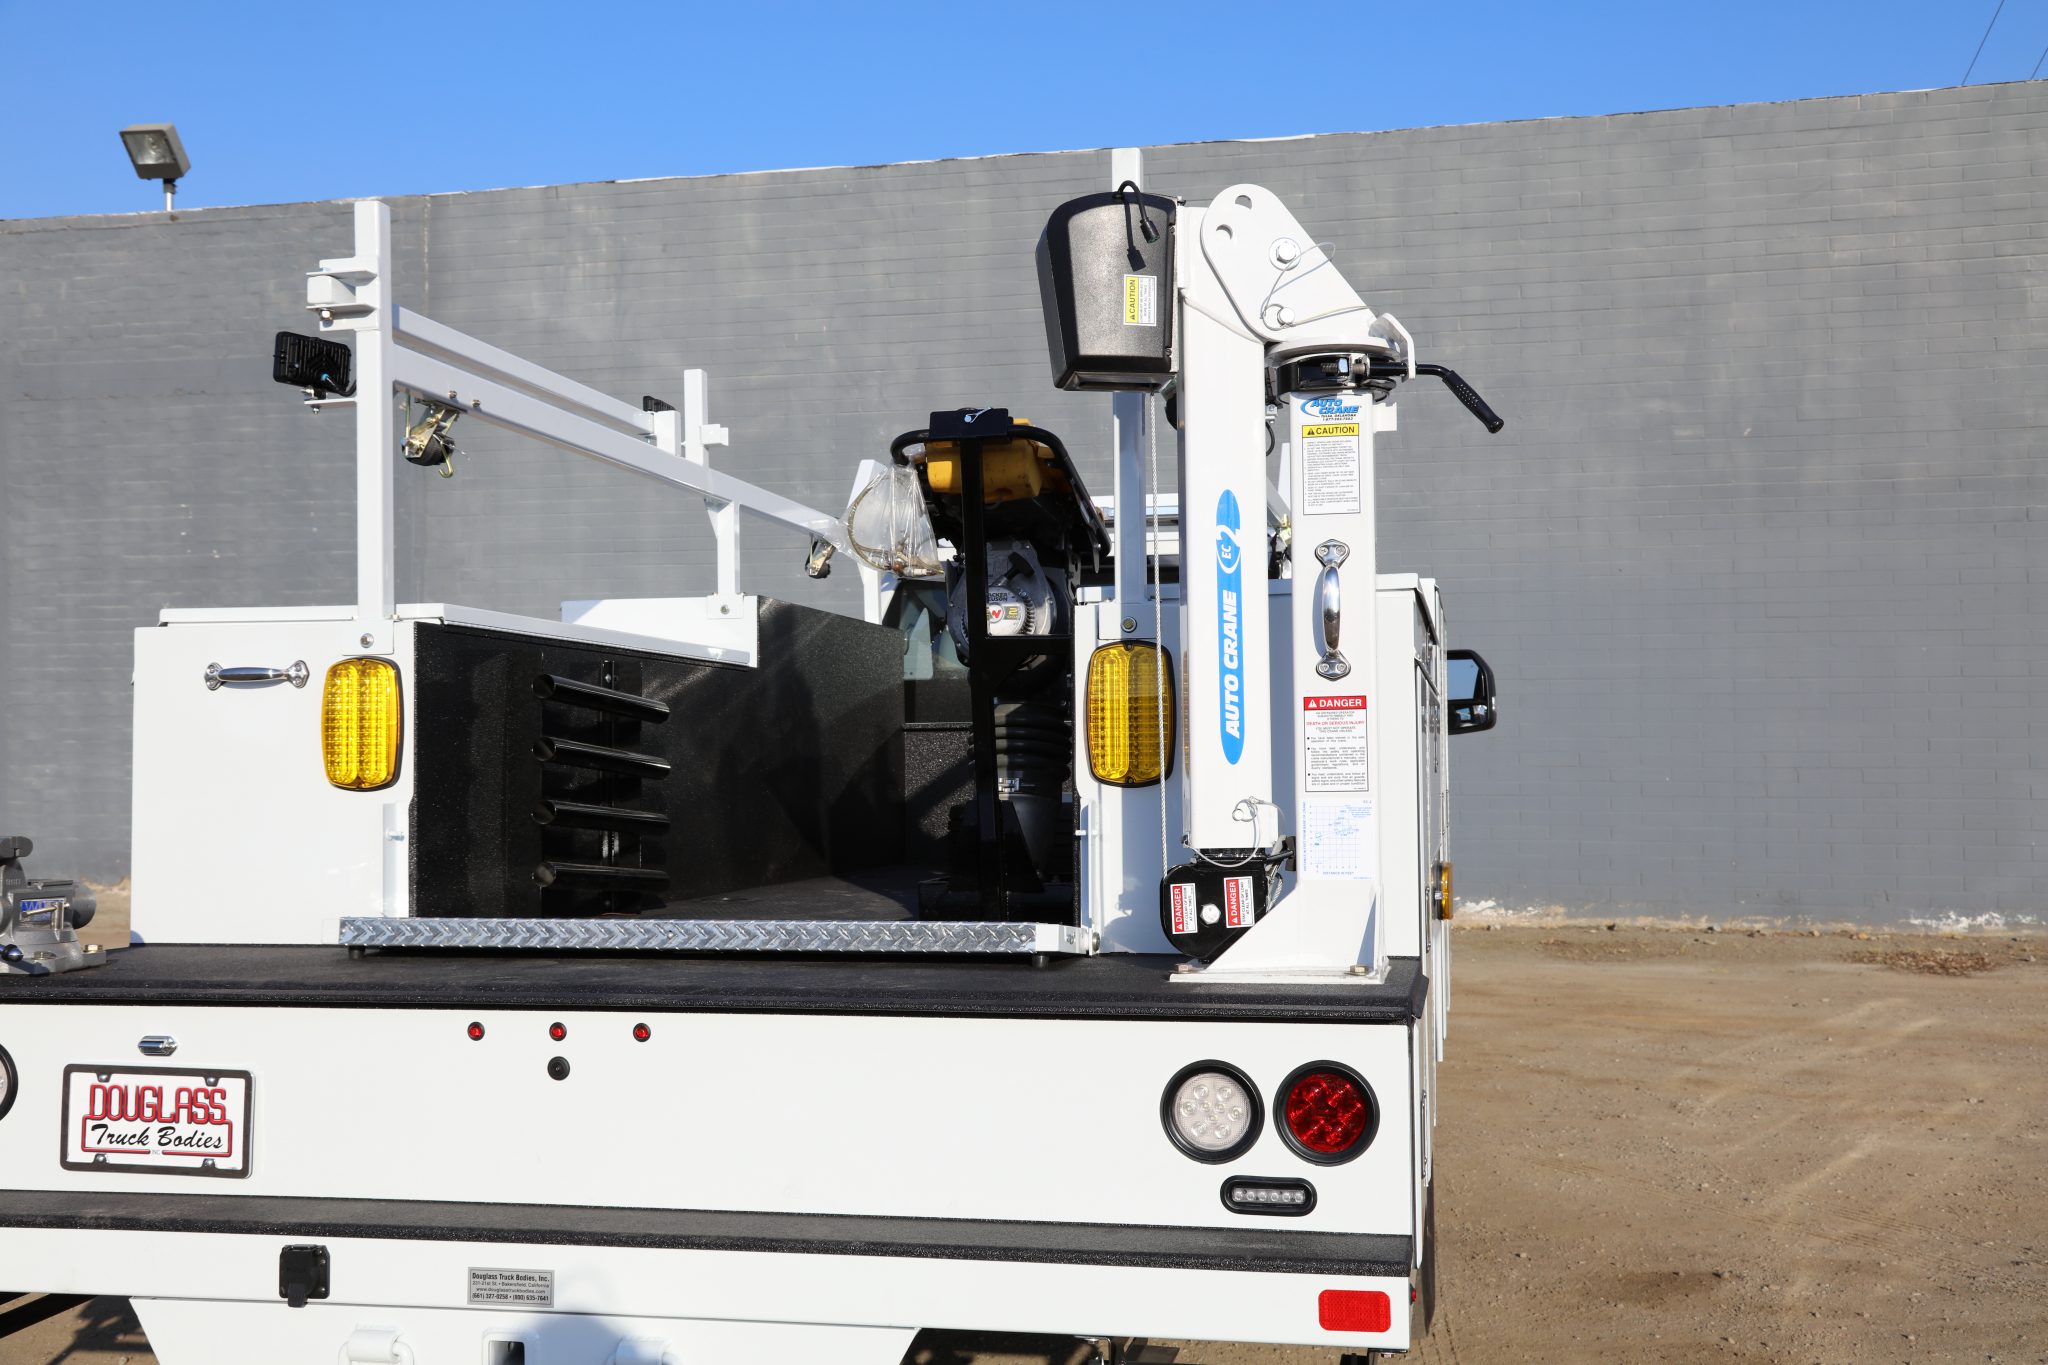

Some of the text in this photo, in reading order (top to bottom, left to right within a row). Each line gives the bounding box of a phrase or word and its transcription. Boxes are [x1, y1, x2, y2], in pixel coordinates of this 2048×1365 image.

[1310, 399, 1342, 407] AUTO
[1319, 406, 1359, 414] CRANE
[1316, 426, 1355, 434] CAUTION
[1216, 524, 1240, 559] EC 2
[1223, 590, 1240, 739] AUTO CRANE
[1320, 699, 1362, 707] DANGER
[1174, 888, 1182, 922] DANGER
[90, 1084, 226, 1124] DOUGLASS
[91, 1124, 223, 1148] Truck Bodies
